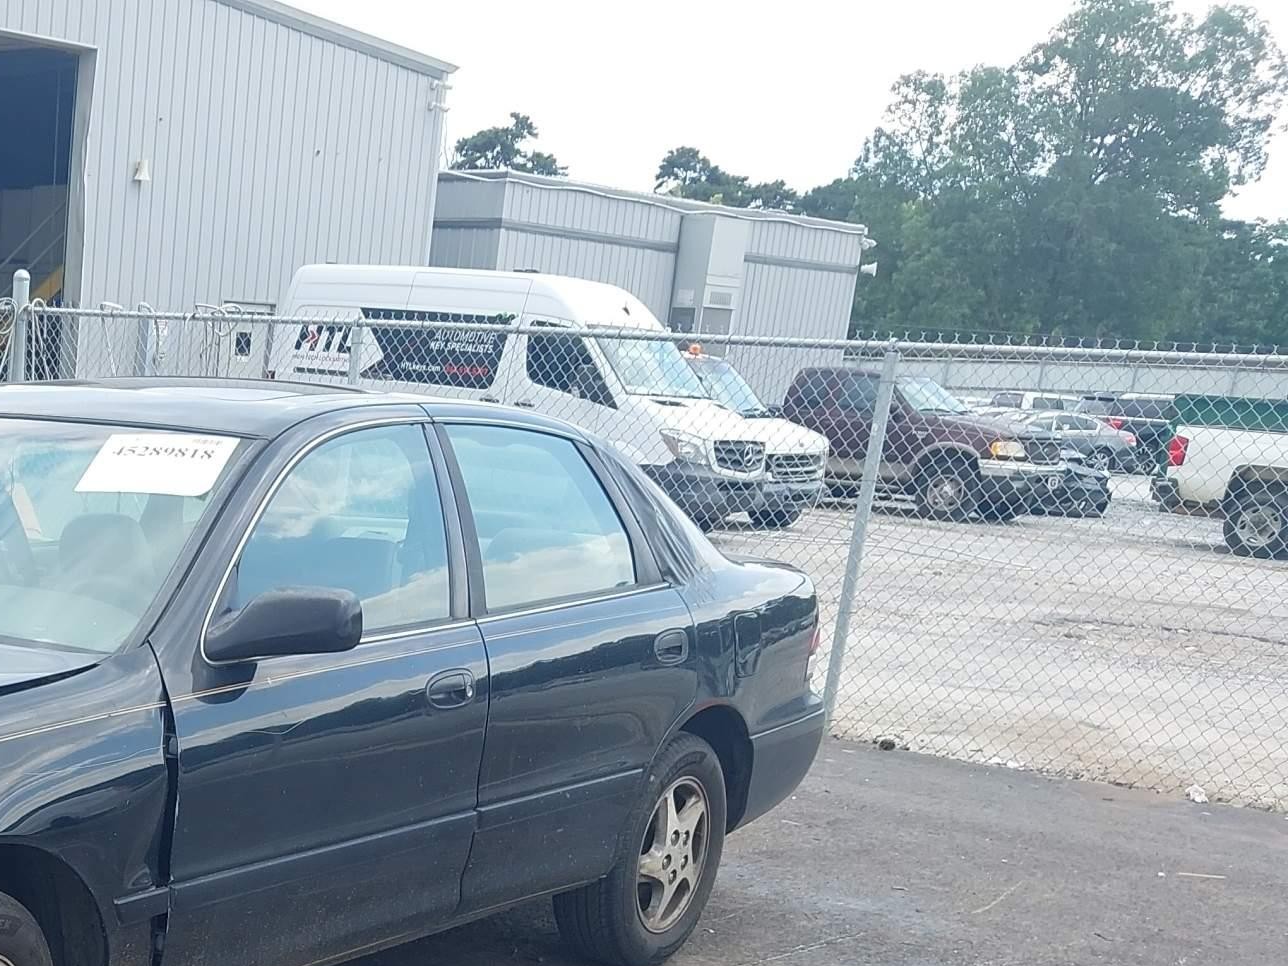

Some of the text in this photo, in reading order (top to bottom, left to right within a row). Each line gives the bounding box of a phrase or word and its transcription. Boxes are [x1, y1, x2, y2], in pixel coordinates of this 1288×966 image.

[434, 328, 497, 344] AUTOMOTIVE
[429, 341, 494, 353] KEY SPECIALISTS
[112, 446, 215, 460] 45289818
